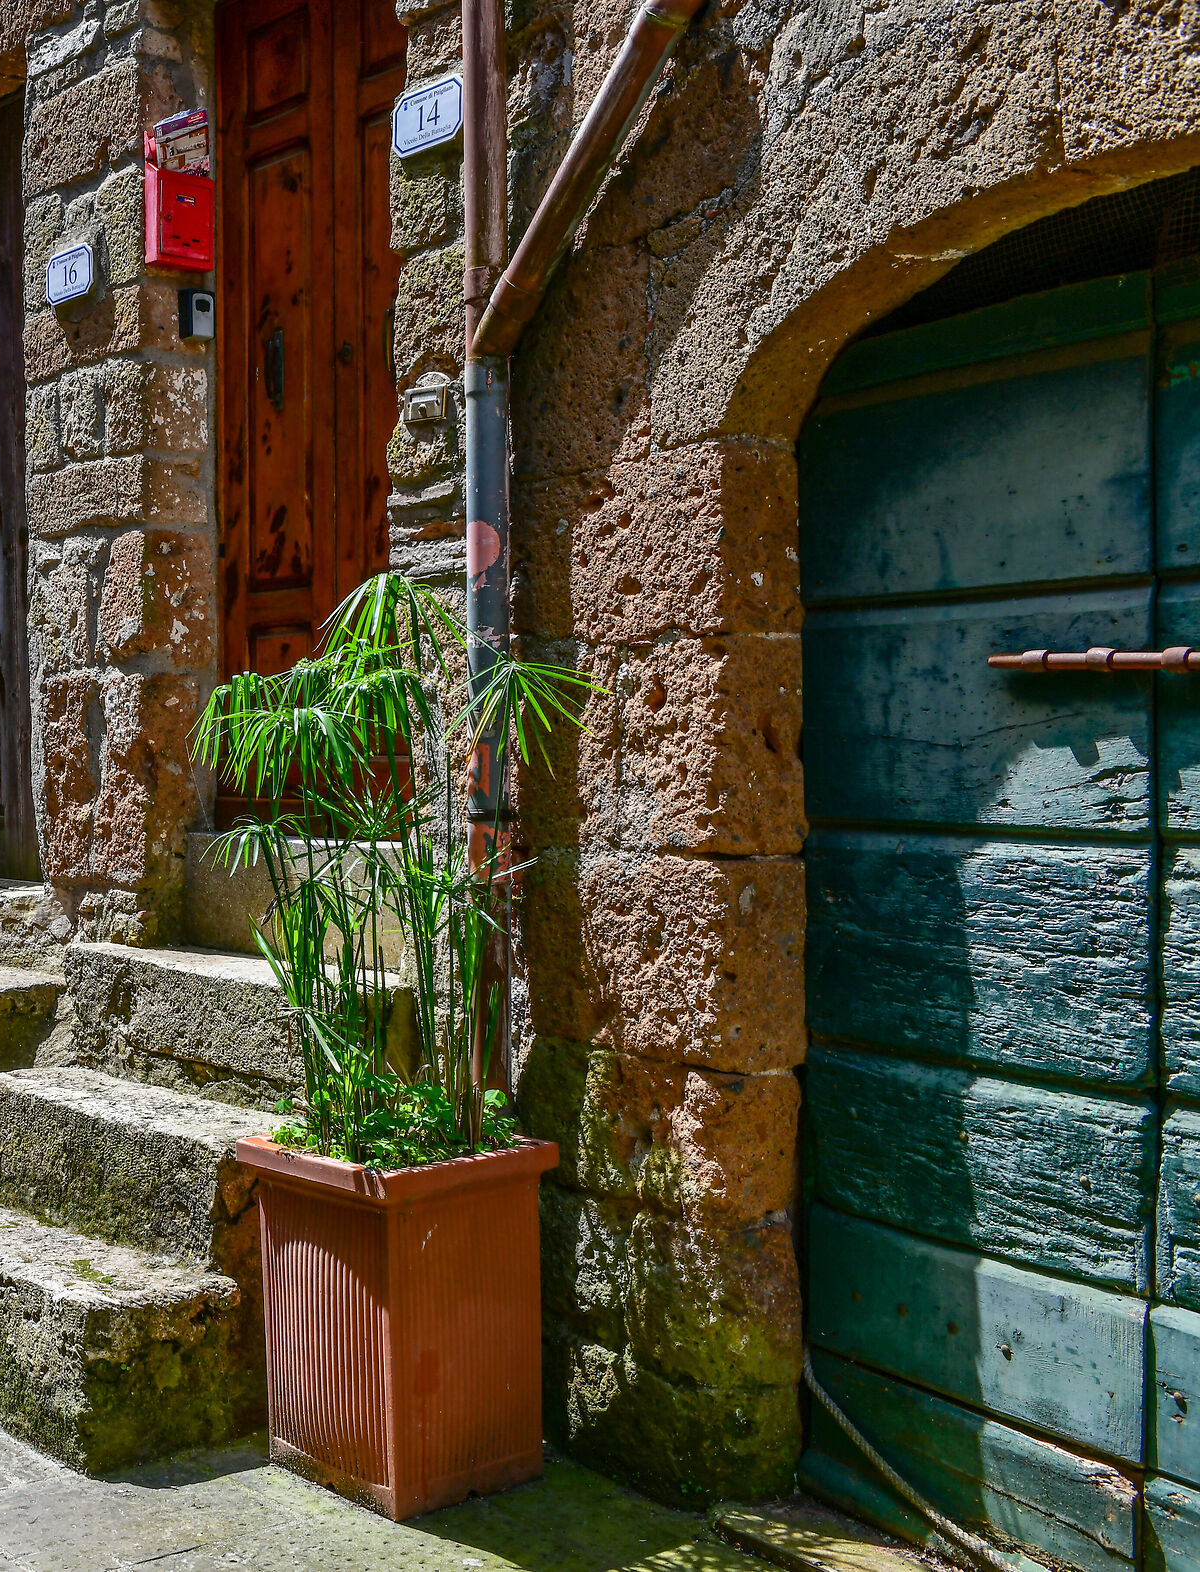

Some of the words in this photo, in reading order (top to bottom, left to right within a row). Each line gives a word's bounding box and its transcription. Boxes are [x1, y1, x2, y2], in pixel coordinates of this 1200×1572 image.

[410, 96, 428, 106] Comune
[433, 85, 454, 97] Pitigliano
[417, 99, 440, 132] 14
[418, 131, 430, 140] Della
[431, 124, 451, 135] Battaglia
[63, 260, 77, 287] 16
